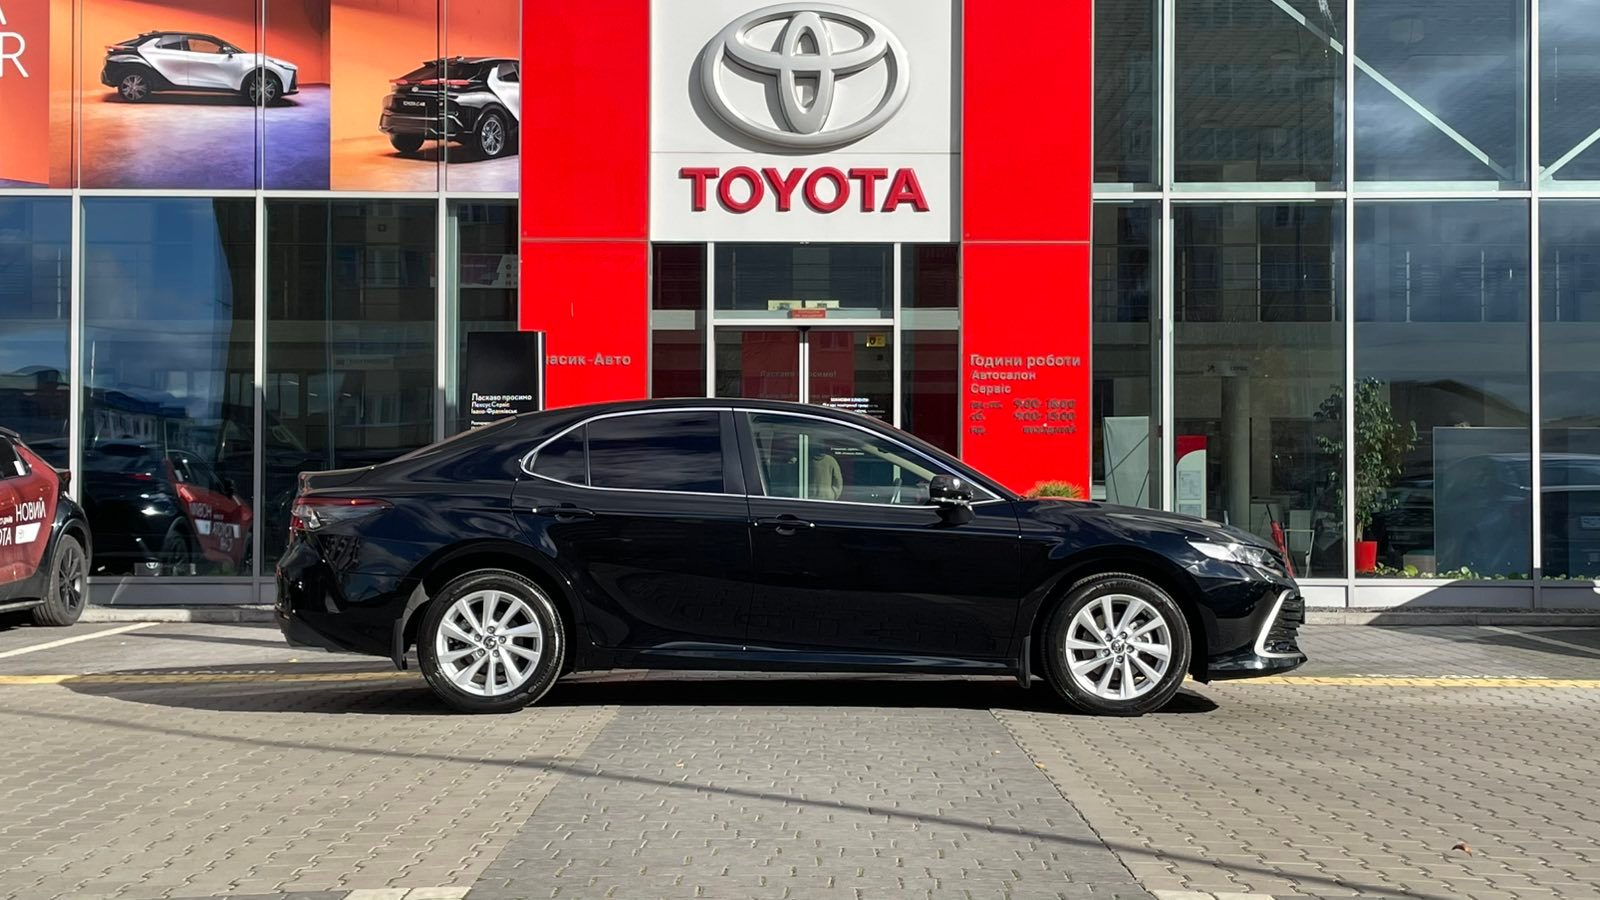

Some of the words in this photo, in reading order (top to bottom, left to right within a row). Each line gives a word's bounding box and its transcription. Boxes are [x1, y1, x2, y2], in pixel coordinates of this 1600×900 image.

[678, 166, 930, 214] TOYOTA
[969, 354, 1023, 368] Години
[1027, 354, 1081, 369] роботи
[971, 370, 1037, 381] Автосалон
[970, 383, 1012, 396] Сервіс
[502, 394, 533, 402] просимо
[15, 497, 47, 522] НОВИЙ
